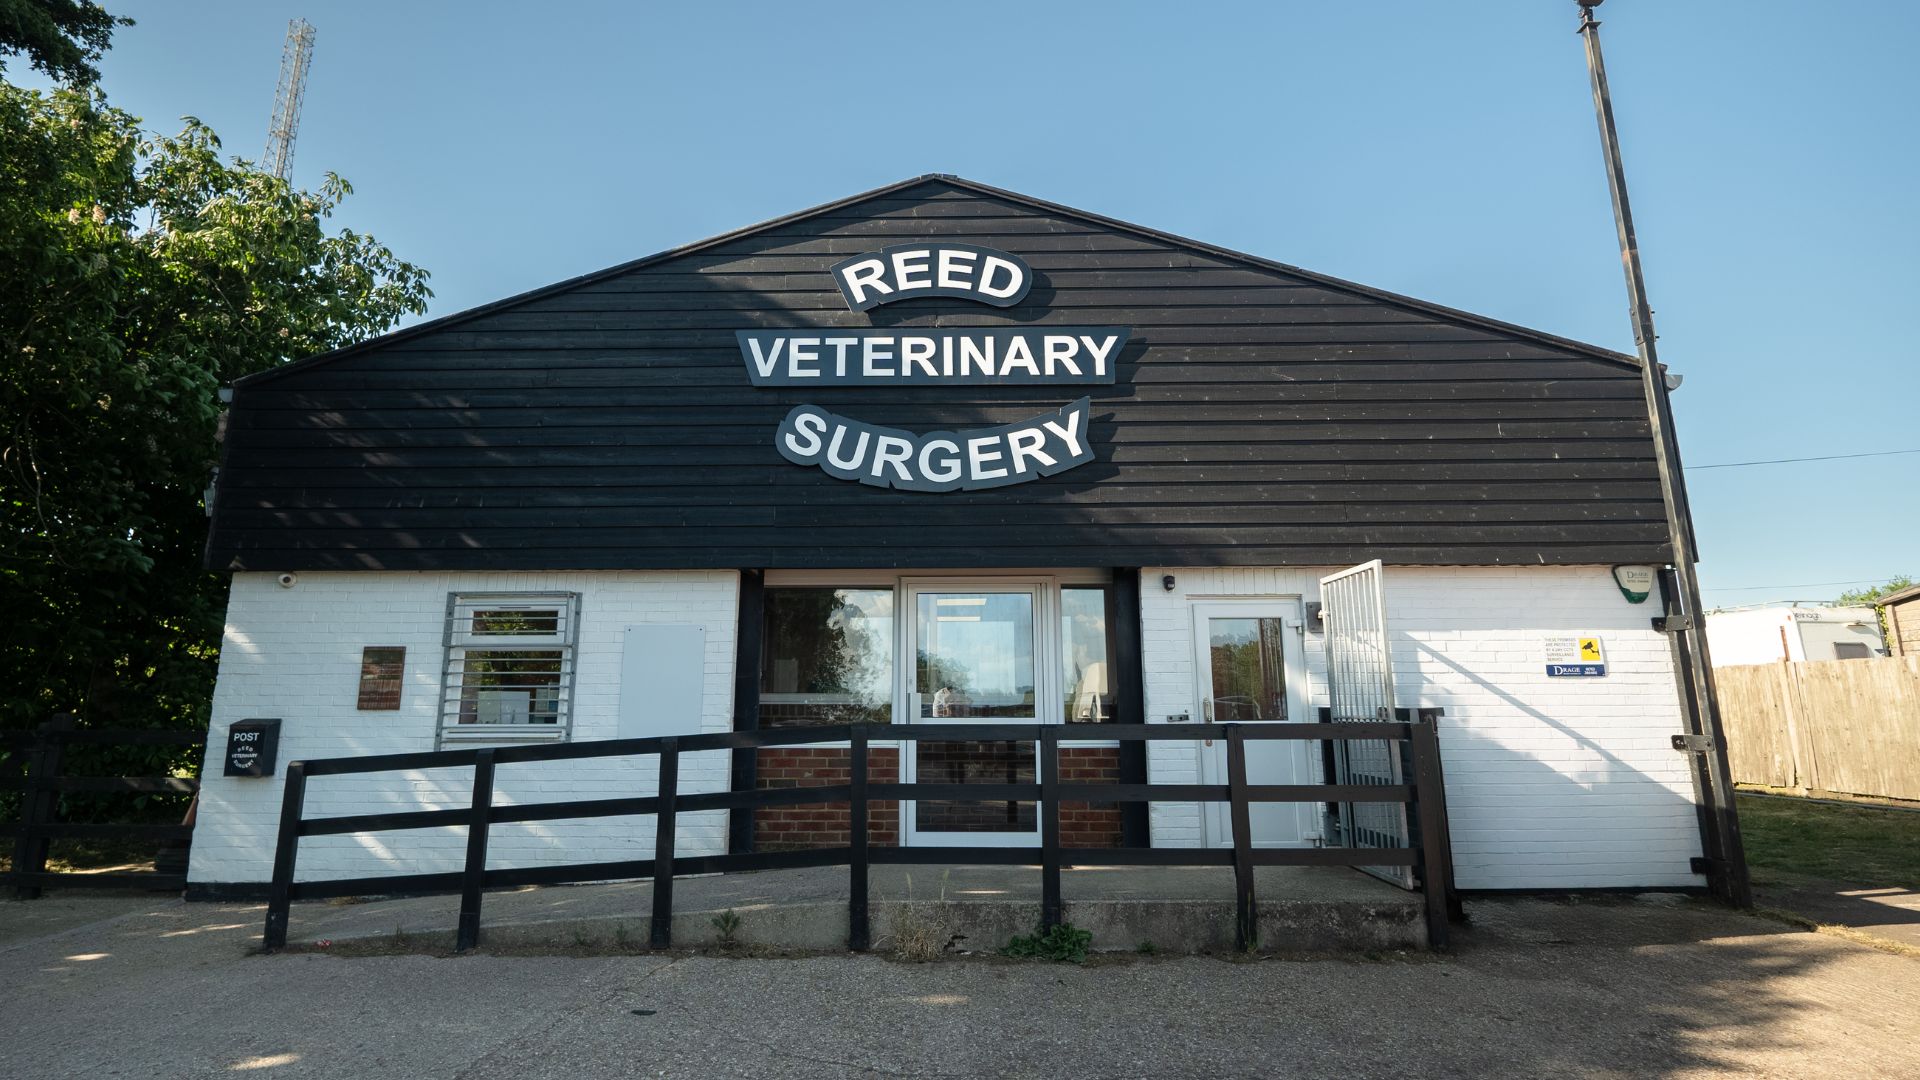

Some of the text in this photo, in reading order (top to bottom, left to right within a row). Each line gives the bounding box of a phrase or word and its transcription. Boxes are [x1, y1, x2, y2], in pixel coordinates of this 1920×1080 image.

[841, 249, 1024, 304] REED
[747, 335, 1119, 378] VETERINARY
[785, 409, 1083, 483] SURGERY
[1553, 665, 1581, 675] DRAGE
[233, 733, 260, 741] POST
